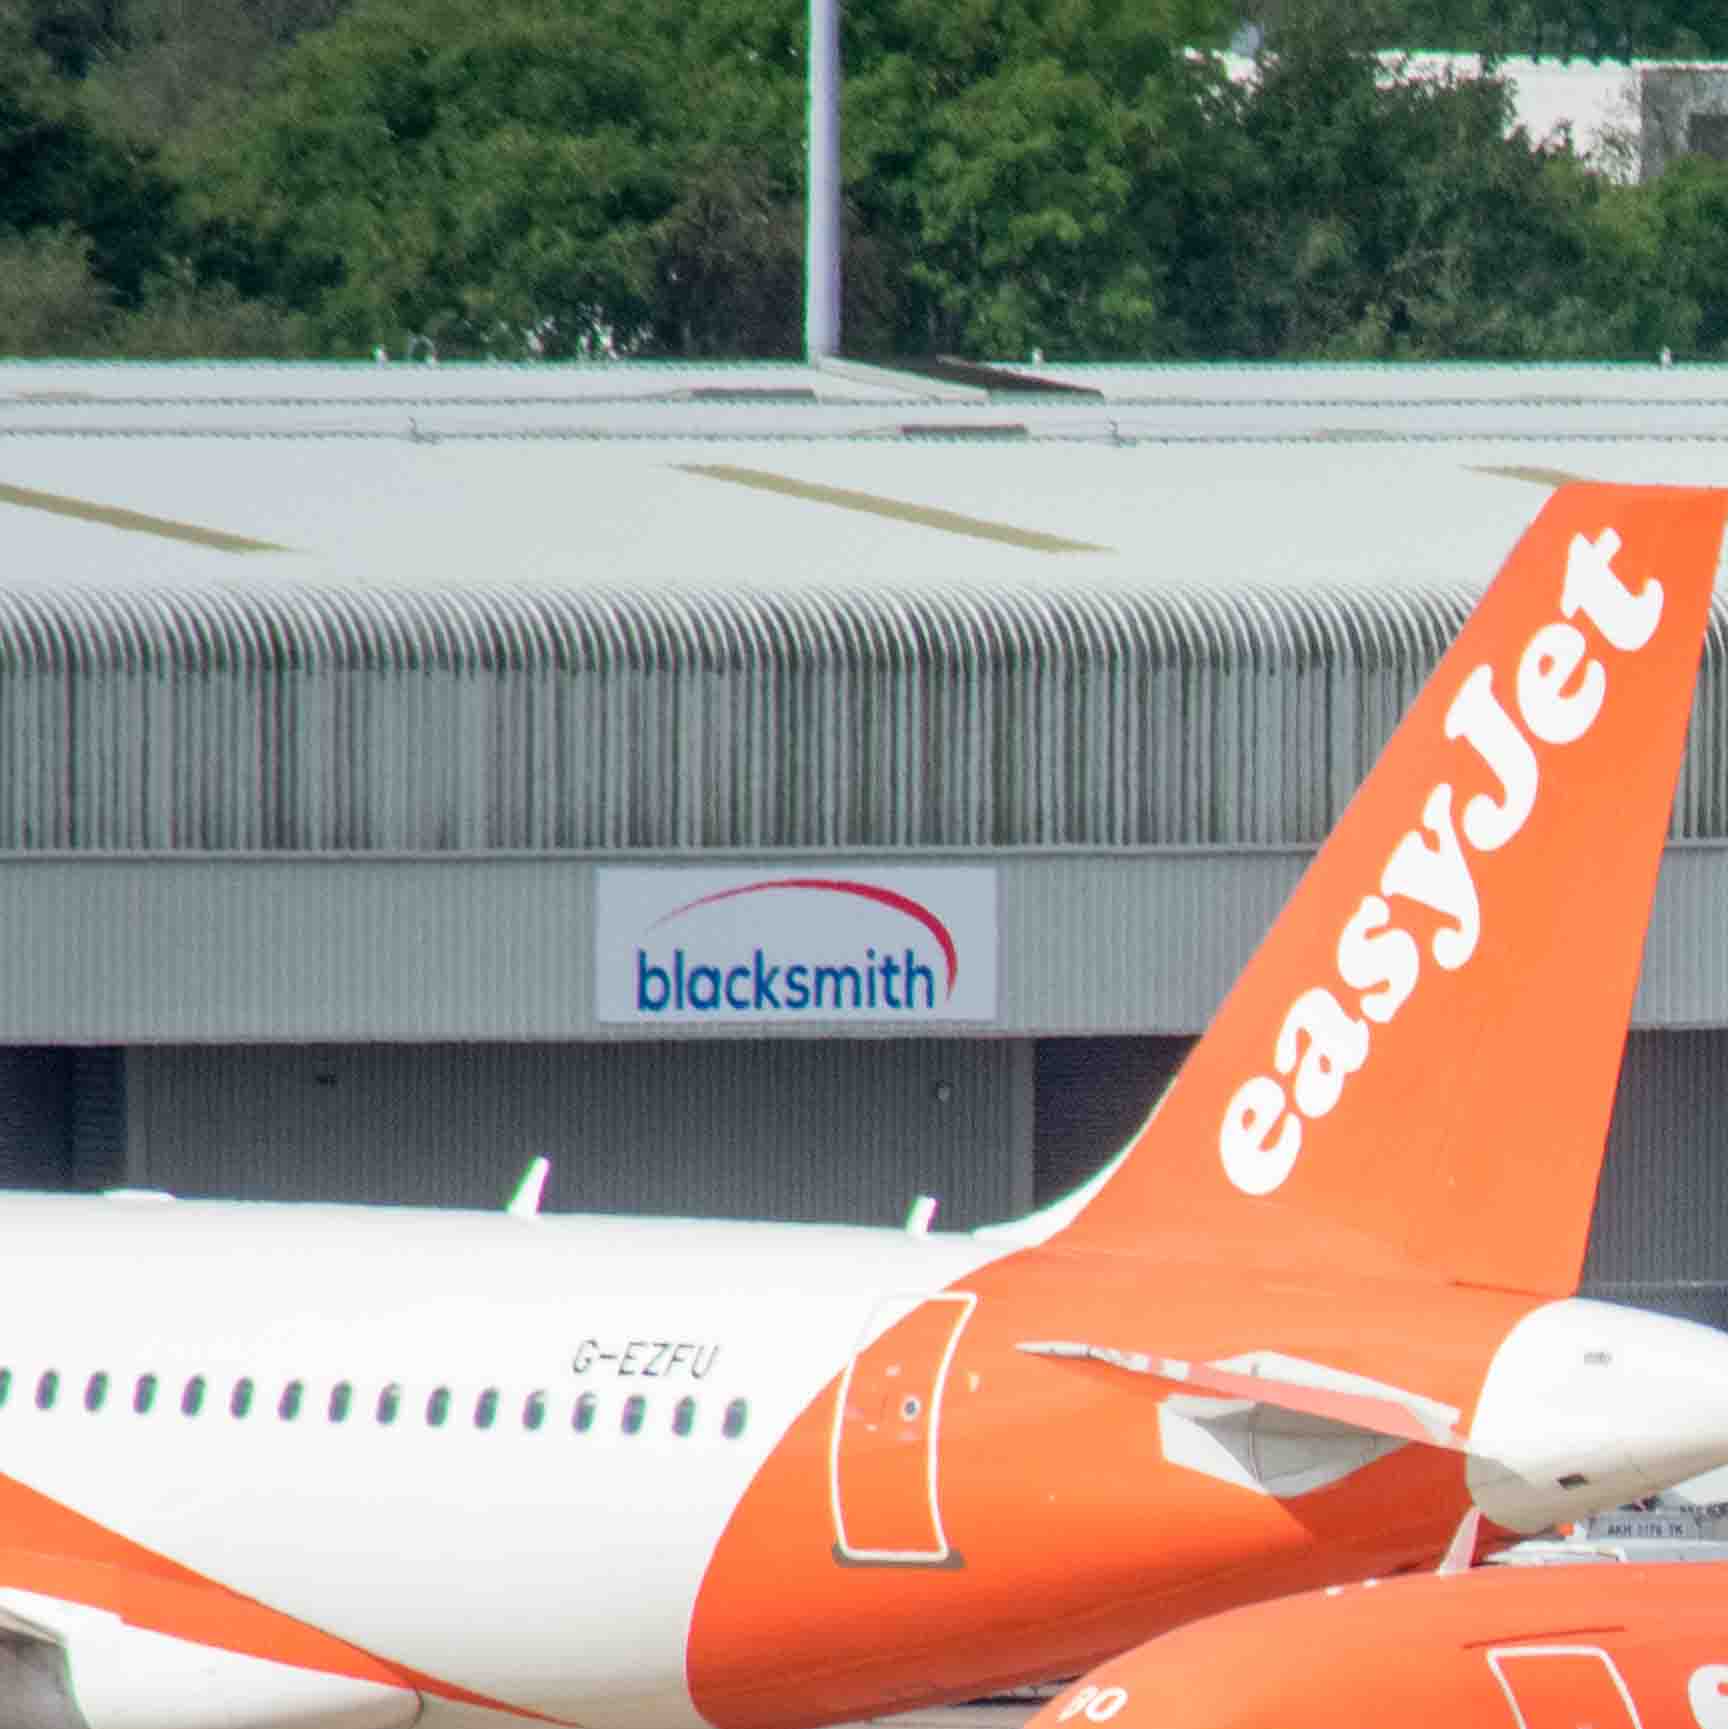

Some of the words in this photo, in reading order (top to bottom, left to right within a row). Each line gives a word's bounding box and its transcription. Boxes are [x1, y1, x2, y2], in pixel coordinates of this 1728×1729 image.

[1219, 526, 1664, 1196] easyJet
[635, 948, 935, 1011] blacksmith
[572, 1339, 721, 1379] G-EZFU
